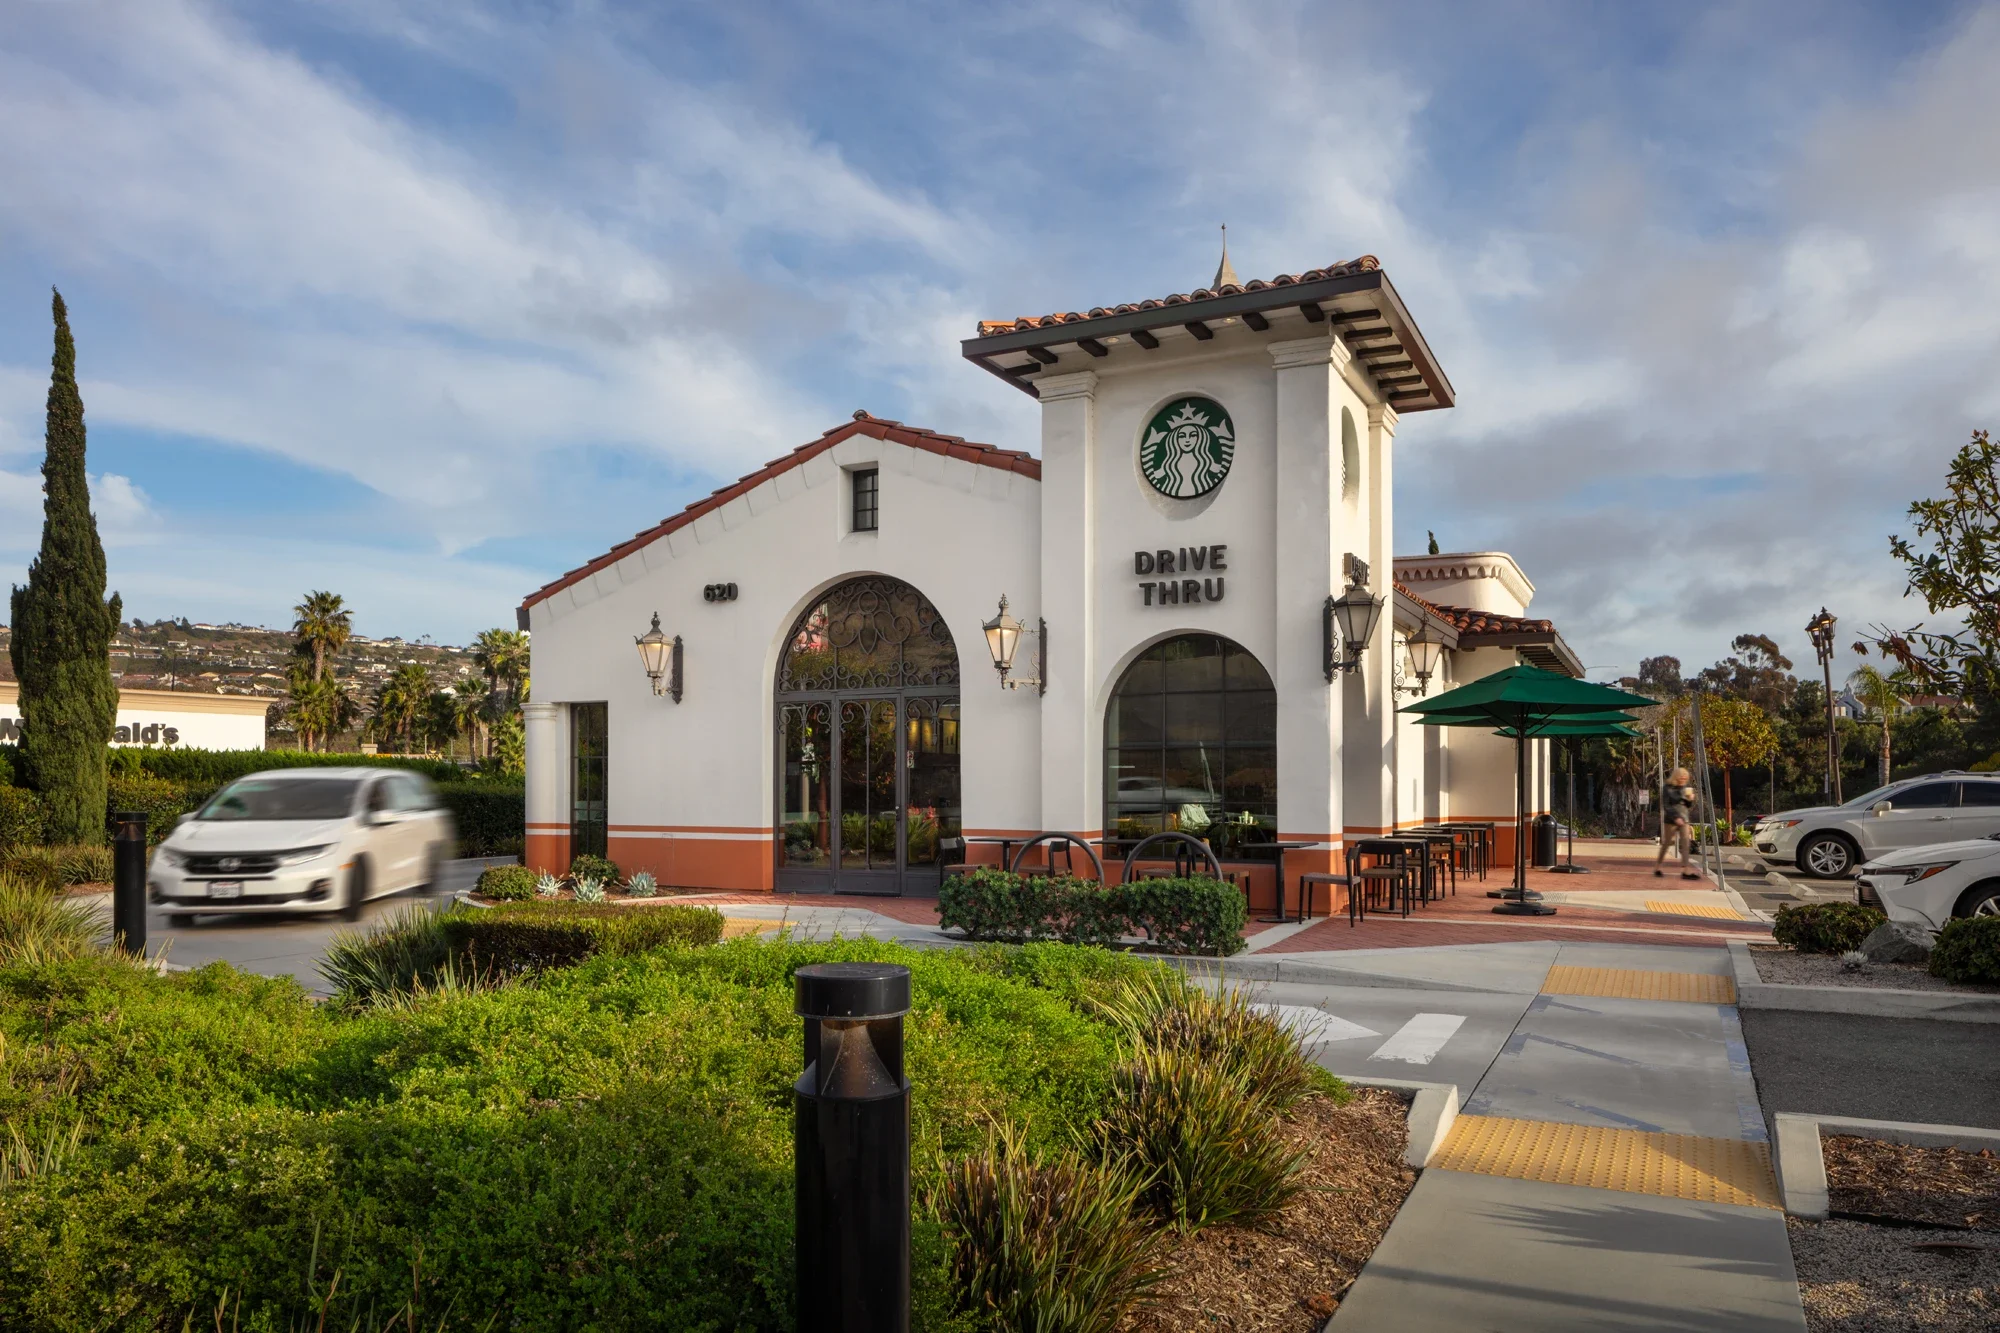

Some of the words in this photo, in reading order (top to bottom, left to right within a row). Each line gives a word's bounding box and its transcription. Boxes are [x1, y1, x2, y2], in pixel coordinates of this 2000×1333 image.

[1135, 545, 1227, 575] DRIVE
[704, 583, 738, 601] 620
[1139, 577, 1225, 606] THRU
